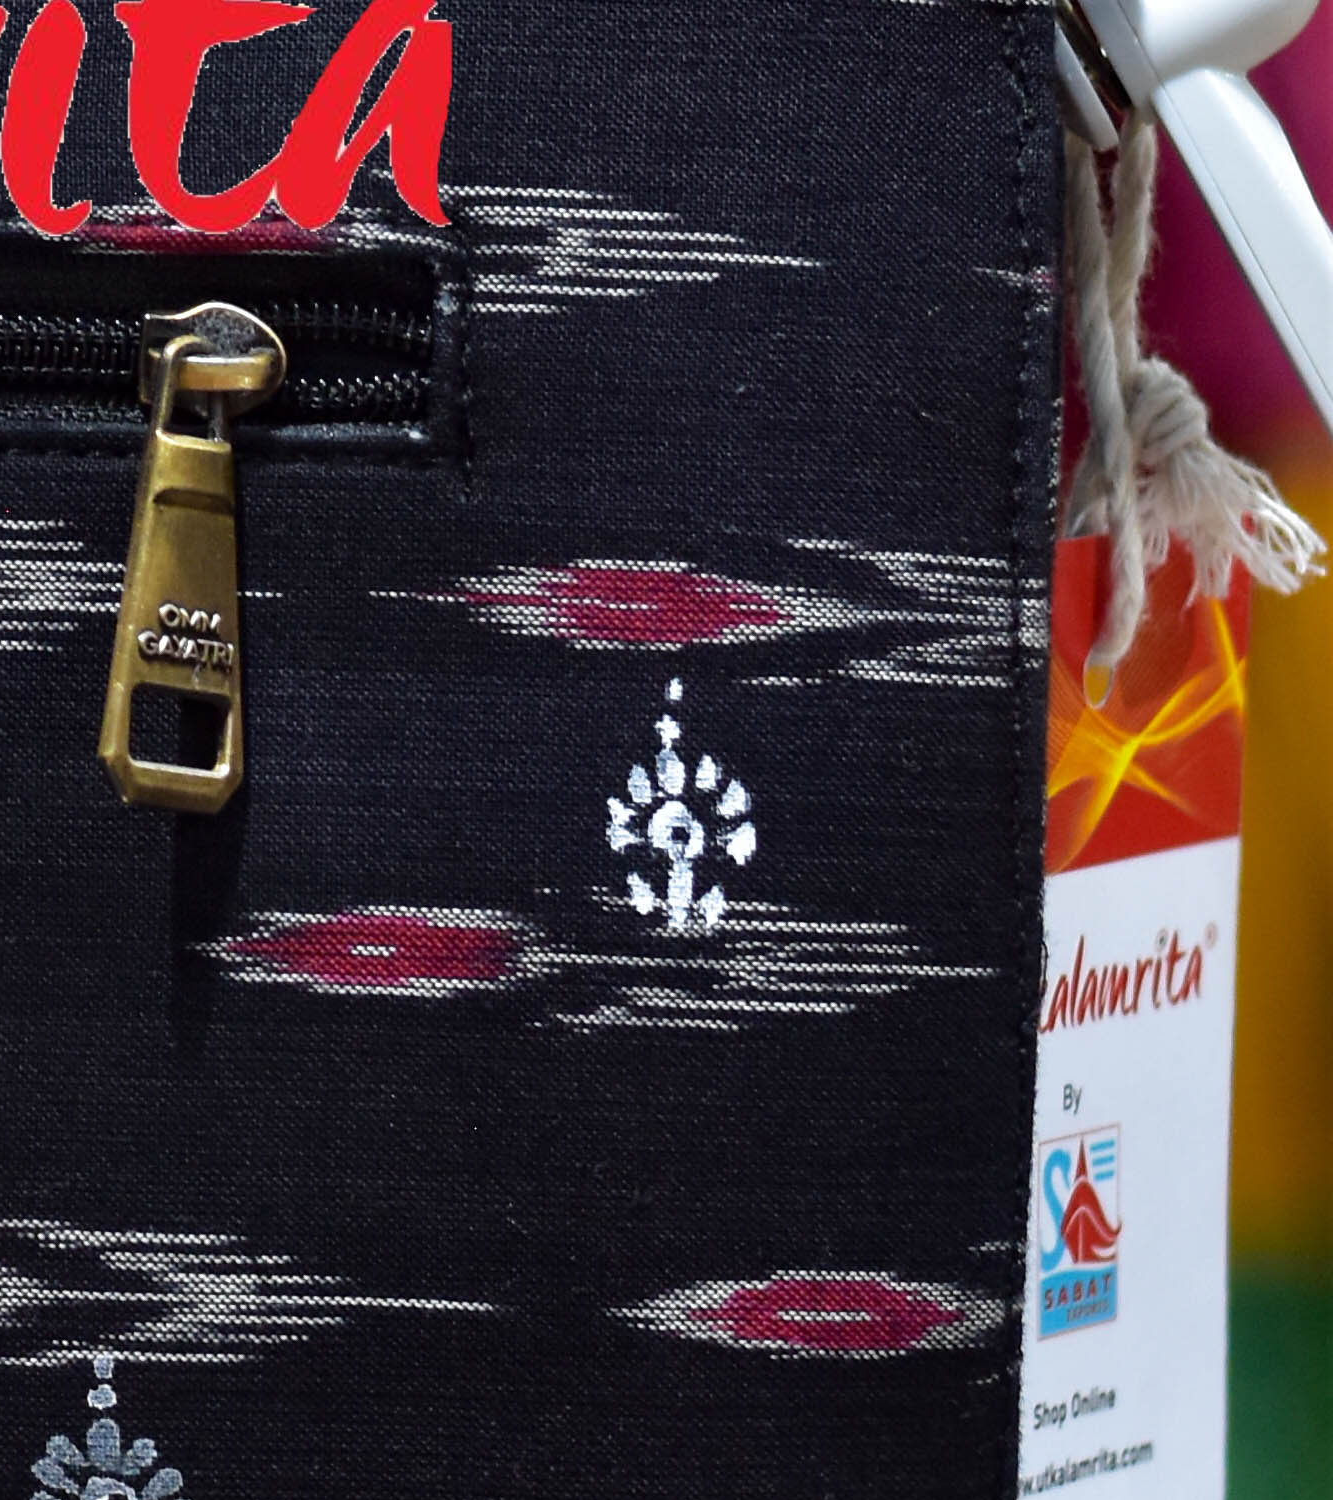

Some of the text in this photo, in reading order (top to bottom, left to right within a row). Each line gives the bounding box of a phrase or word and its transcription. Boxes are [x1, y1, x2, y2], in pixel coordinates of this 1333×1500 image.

[158, 603, 222, 635] OMM
[137, 630, 234, 665] GAYATRI
[1037, 928, 1203, 1035] alamrita
[1063, 1083, 1082, 1114] By
[1044, 1272, 1112, 1310] SABAT
[1033, 1386, 1116, 1430] Shop Online
